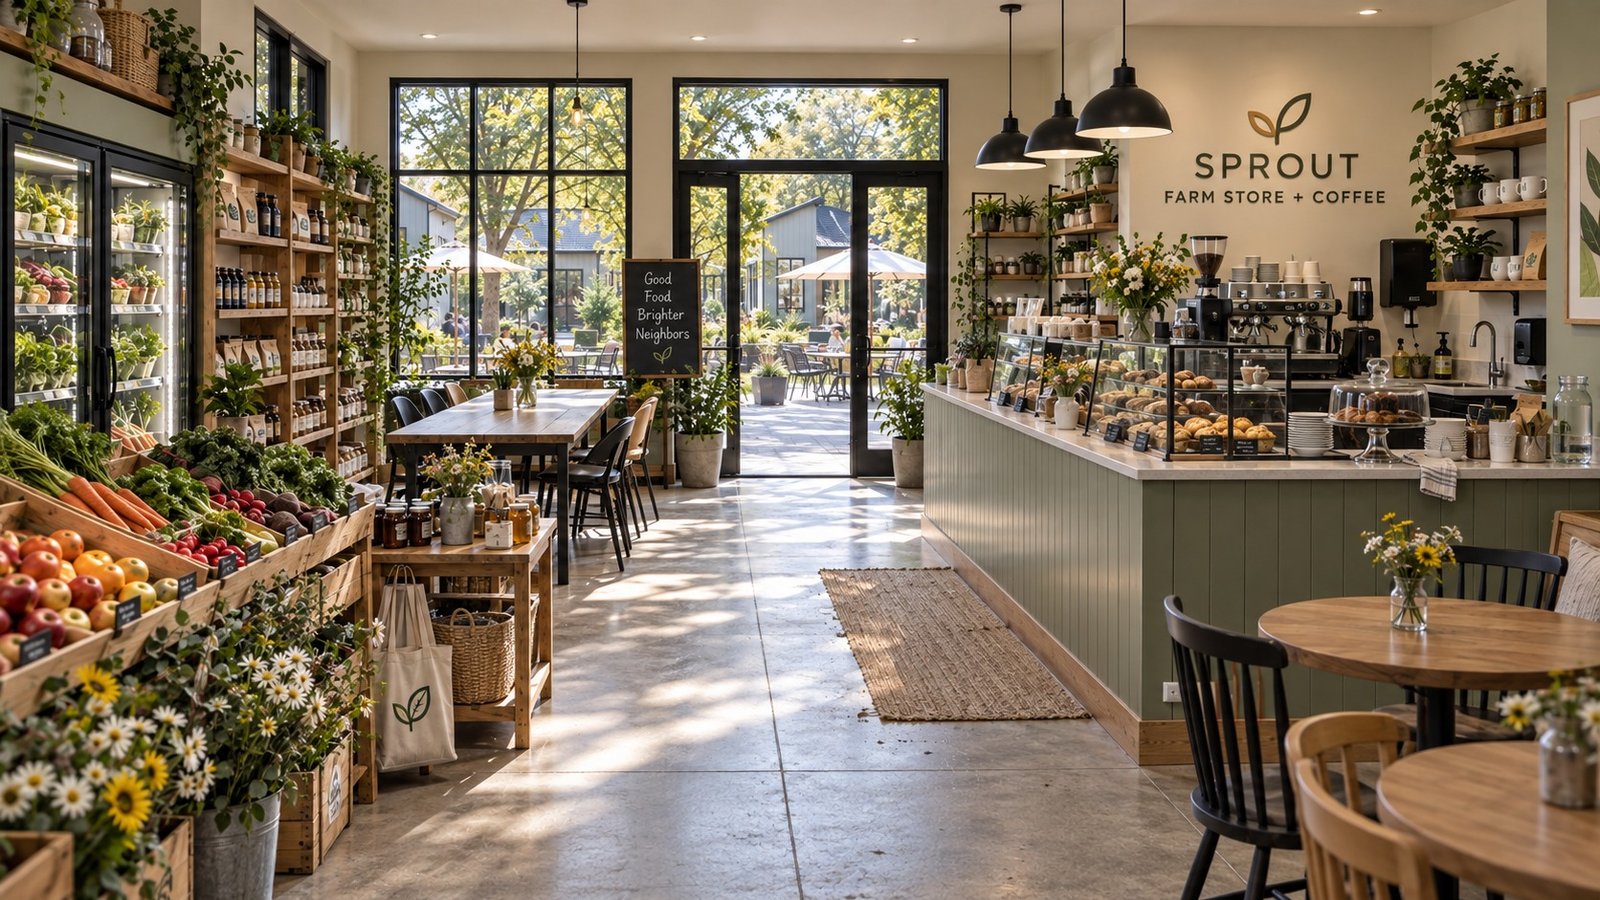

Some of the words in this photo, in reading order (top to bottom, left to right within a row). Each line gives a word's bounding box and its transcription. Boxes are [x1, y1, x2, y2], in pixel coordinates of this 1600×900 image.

[1195, 153, 1359, 179] SPROUT
[1165, 190, 1215, 204] FARM
[1224, 190, 1284, 204] STORE
[1293, 193, 1303, 202] +
[1313, 190, 1386, 204] COFFEE
[644, 271, 672, 285] Good
[644, 290, 672, 302] Food
[637, 308, 684, 325] Brighter
[636, 326, 690, 344] Neighbors
